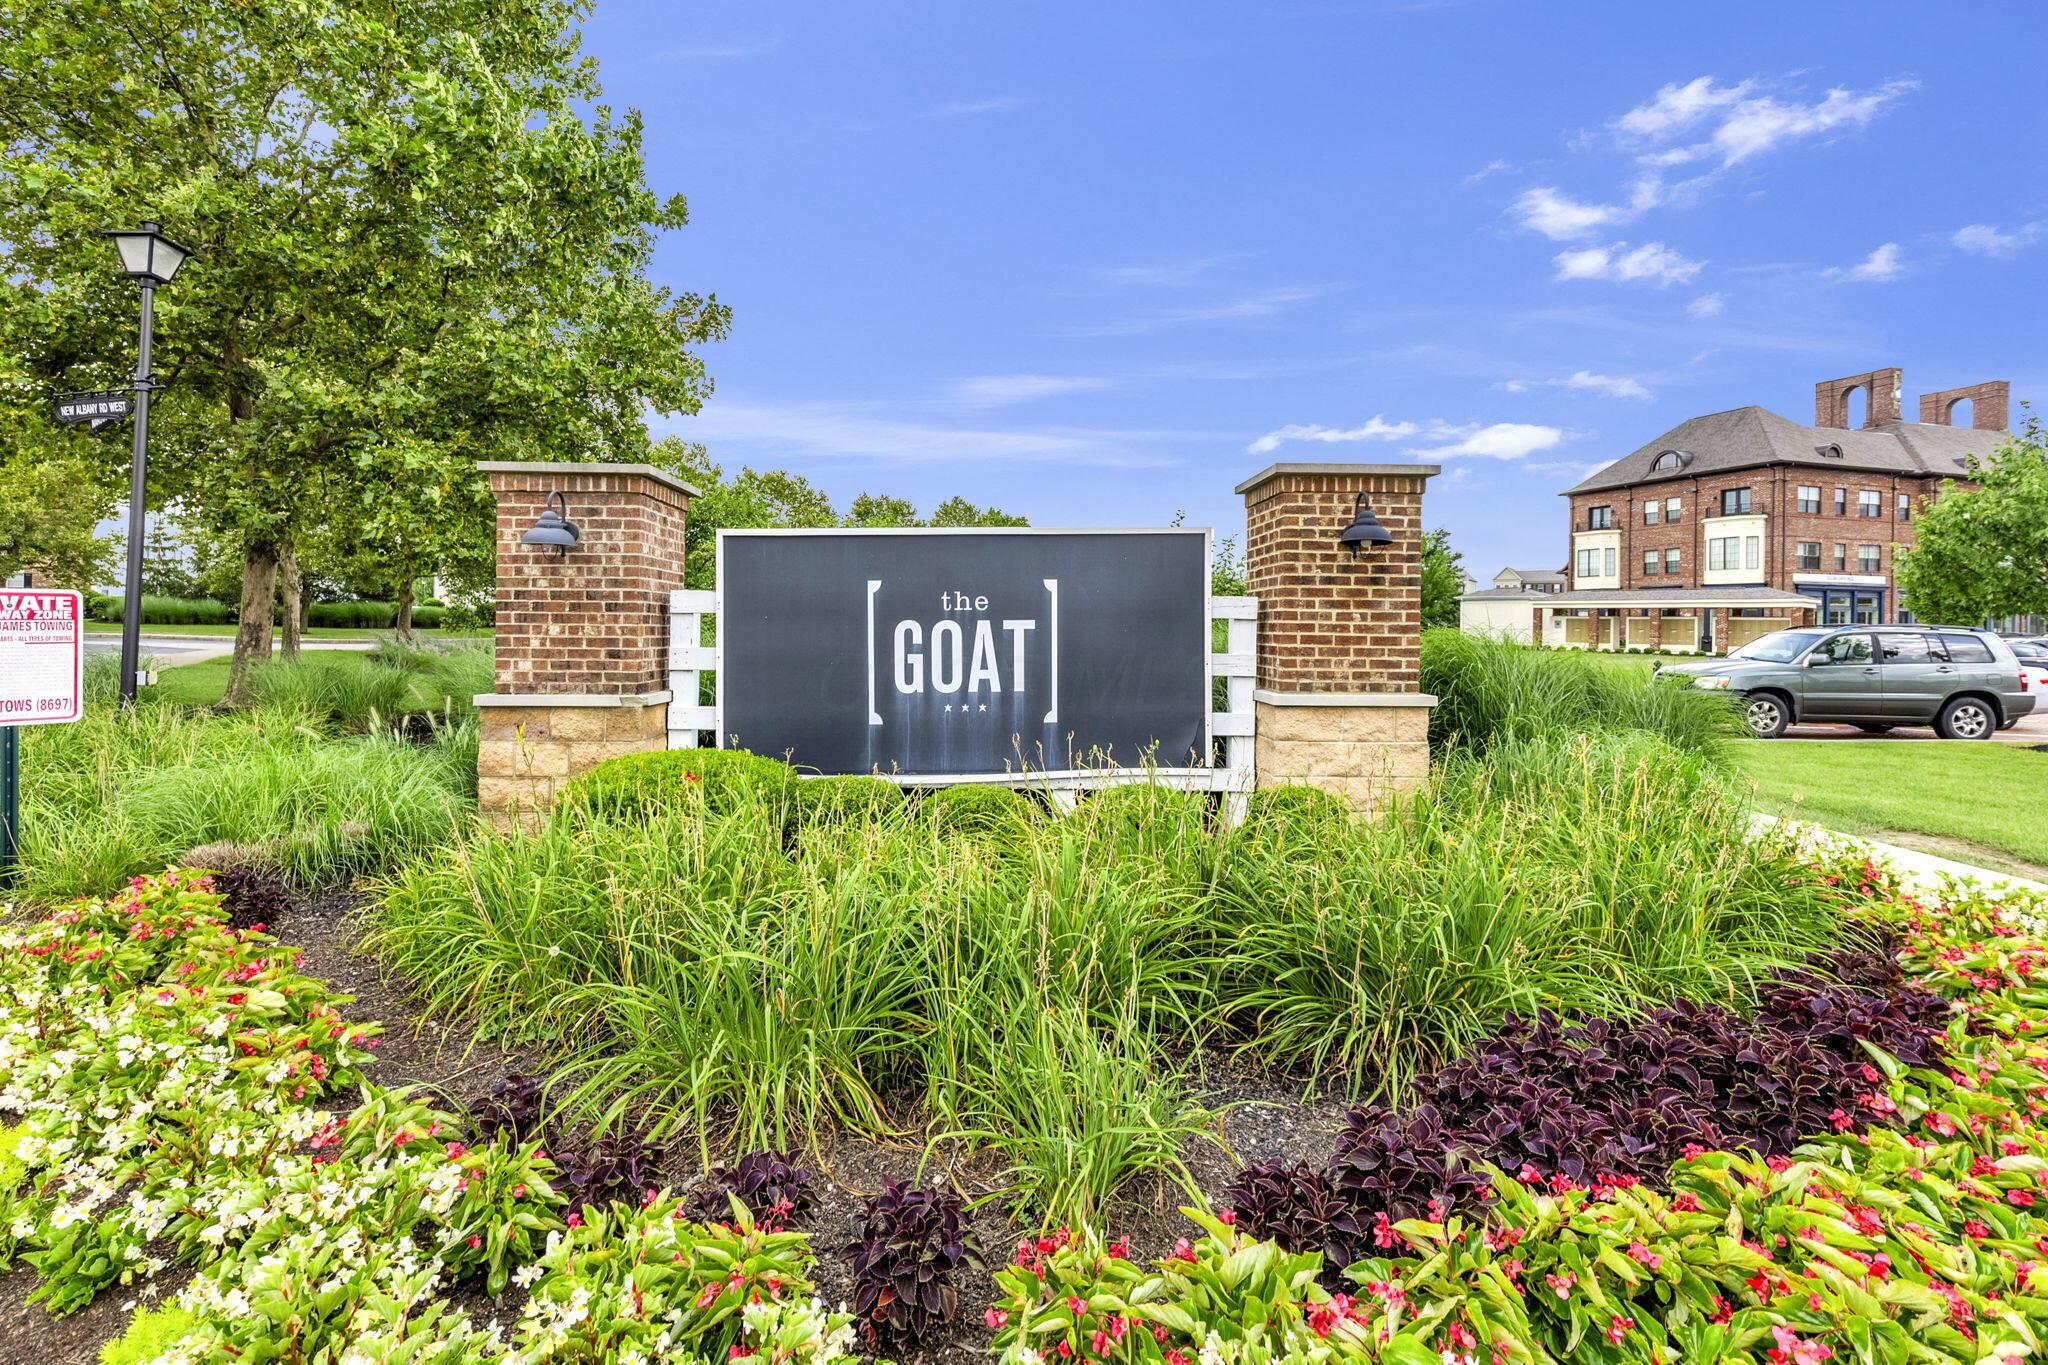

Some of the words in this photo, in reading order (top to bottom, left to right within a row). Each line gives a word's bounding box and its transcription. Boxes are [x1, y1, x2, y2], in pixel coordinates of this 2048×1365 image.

[60, 405, 75, 416] NEW
[76, 403, 98, 416] ALBANY
[98, 402, 108, 413] RD
[108, 401, 126, 412] WEST
[0, 595, 73, 611] VATE
[941, 591, 989, 611] the
[33, 610, 73, 620] ZONE
[34, 621, 73, 631] TOWING
[894, 619, 1036, 694] GOAT
[0, 699, 32, 713] TOWS
[36, 697, 73, 712] (8697)
